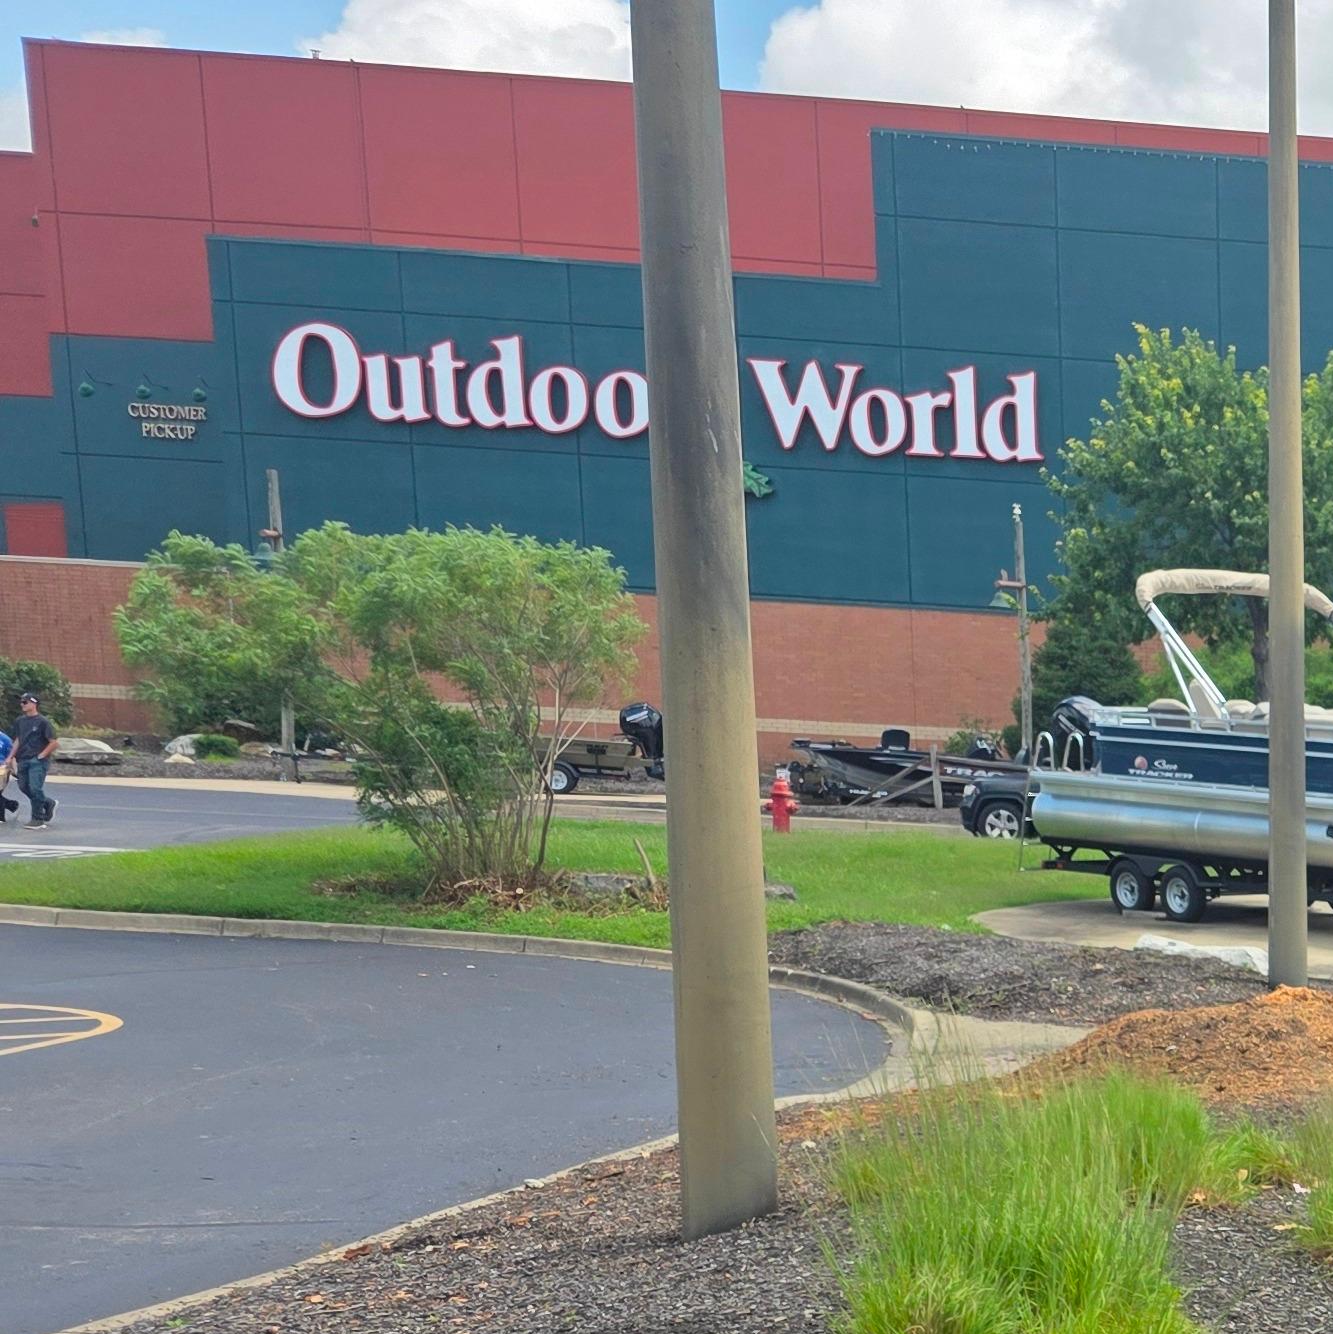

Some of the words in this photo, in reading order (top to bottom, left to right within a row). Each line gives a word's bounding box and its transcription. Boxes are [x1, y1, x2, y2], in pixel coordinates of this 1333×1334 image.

[272, 321, 650, 438] Outdoo
[745, 357, 1046, 464] World
[127, 402, 208, 421] CUSTOMER
[141, 422, 196, 440] PICK-UP
[943, 766, 1006, 777] TRAC
